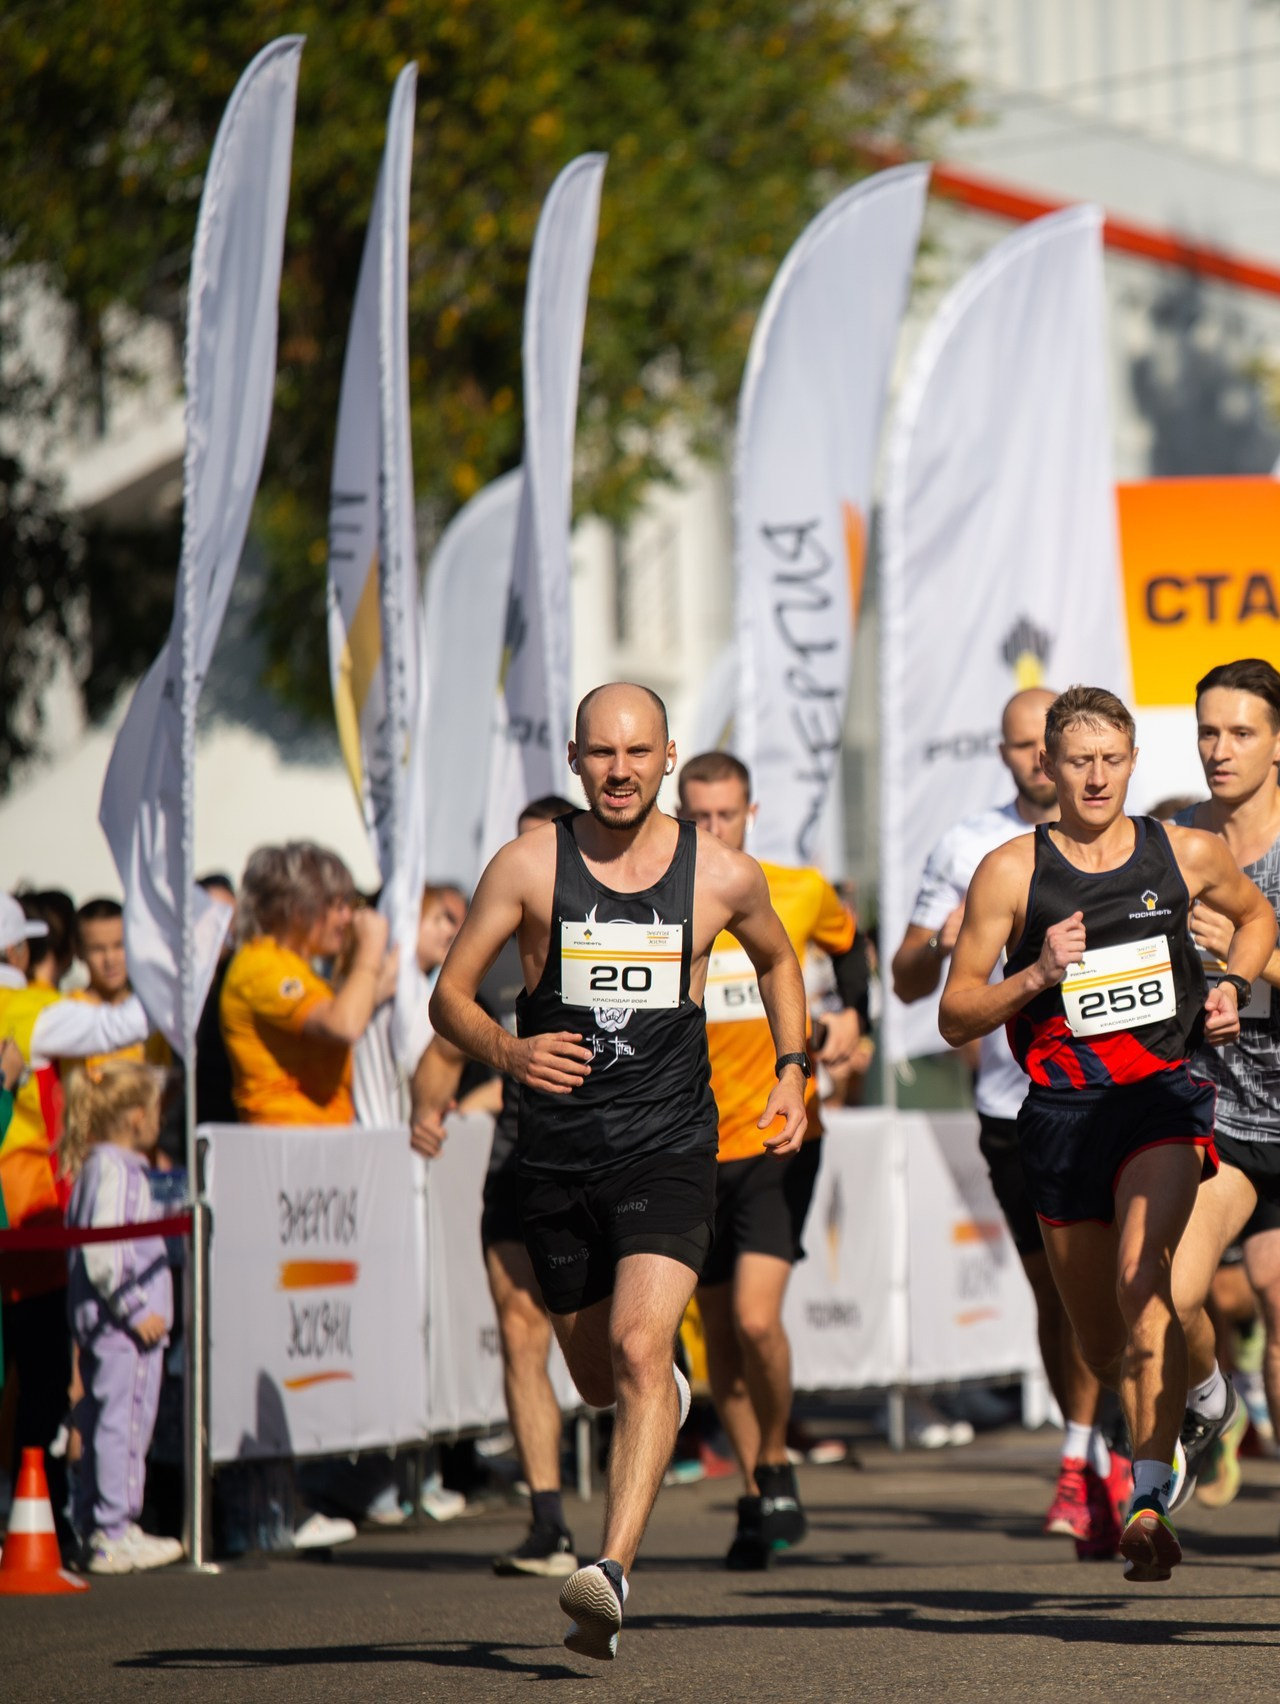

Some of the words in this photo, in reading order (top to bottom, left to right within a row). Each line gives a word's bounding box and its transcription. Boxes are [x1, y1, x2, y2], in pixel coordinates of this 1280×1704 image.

[1128, 909, 1172, 920] РОСНЕФТЬ
[590, 965, 652, 992] 20
[1078, 979, 1164, 1021] 258
